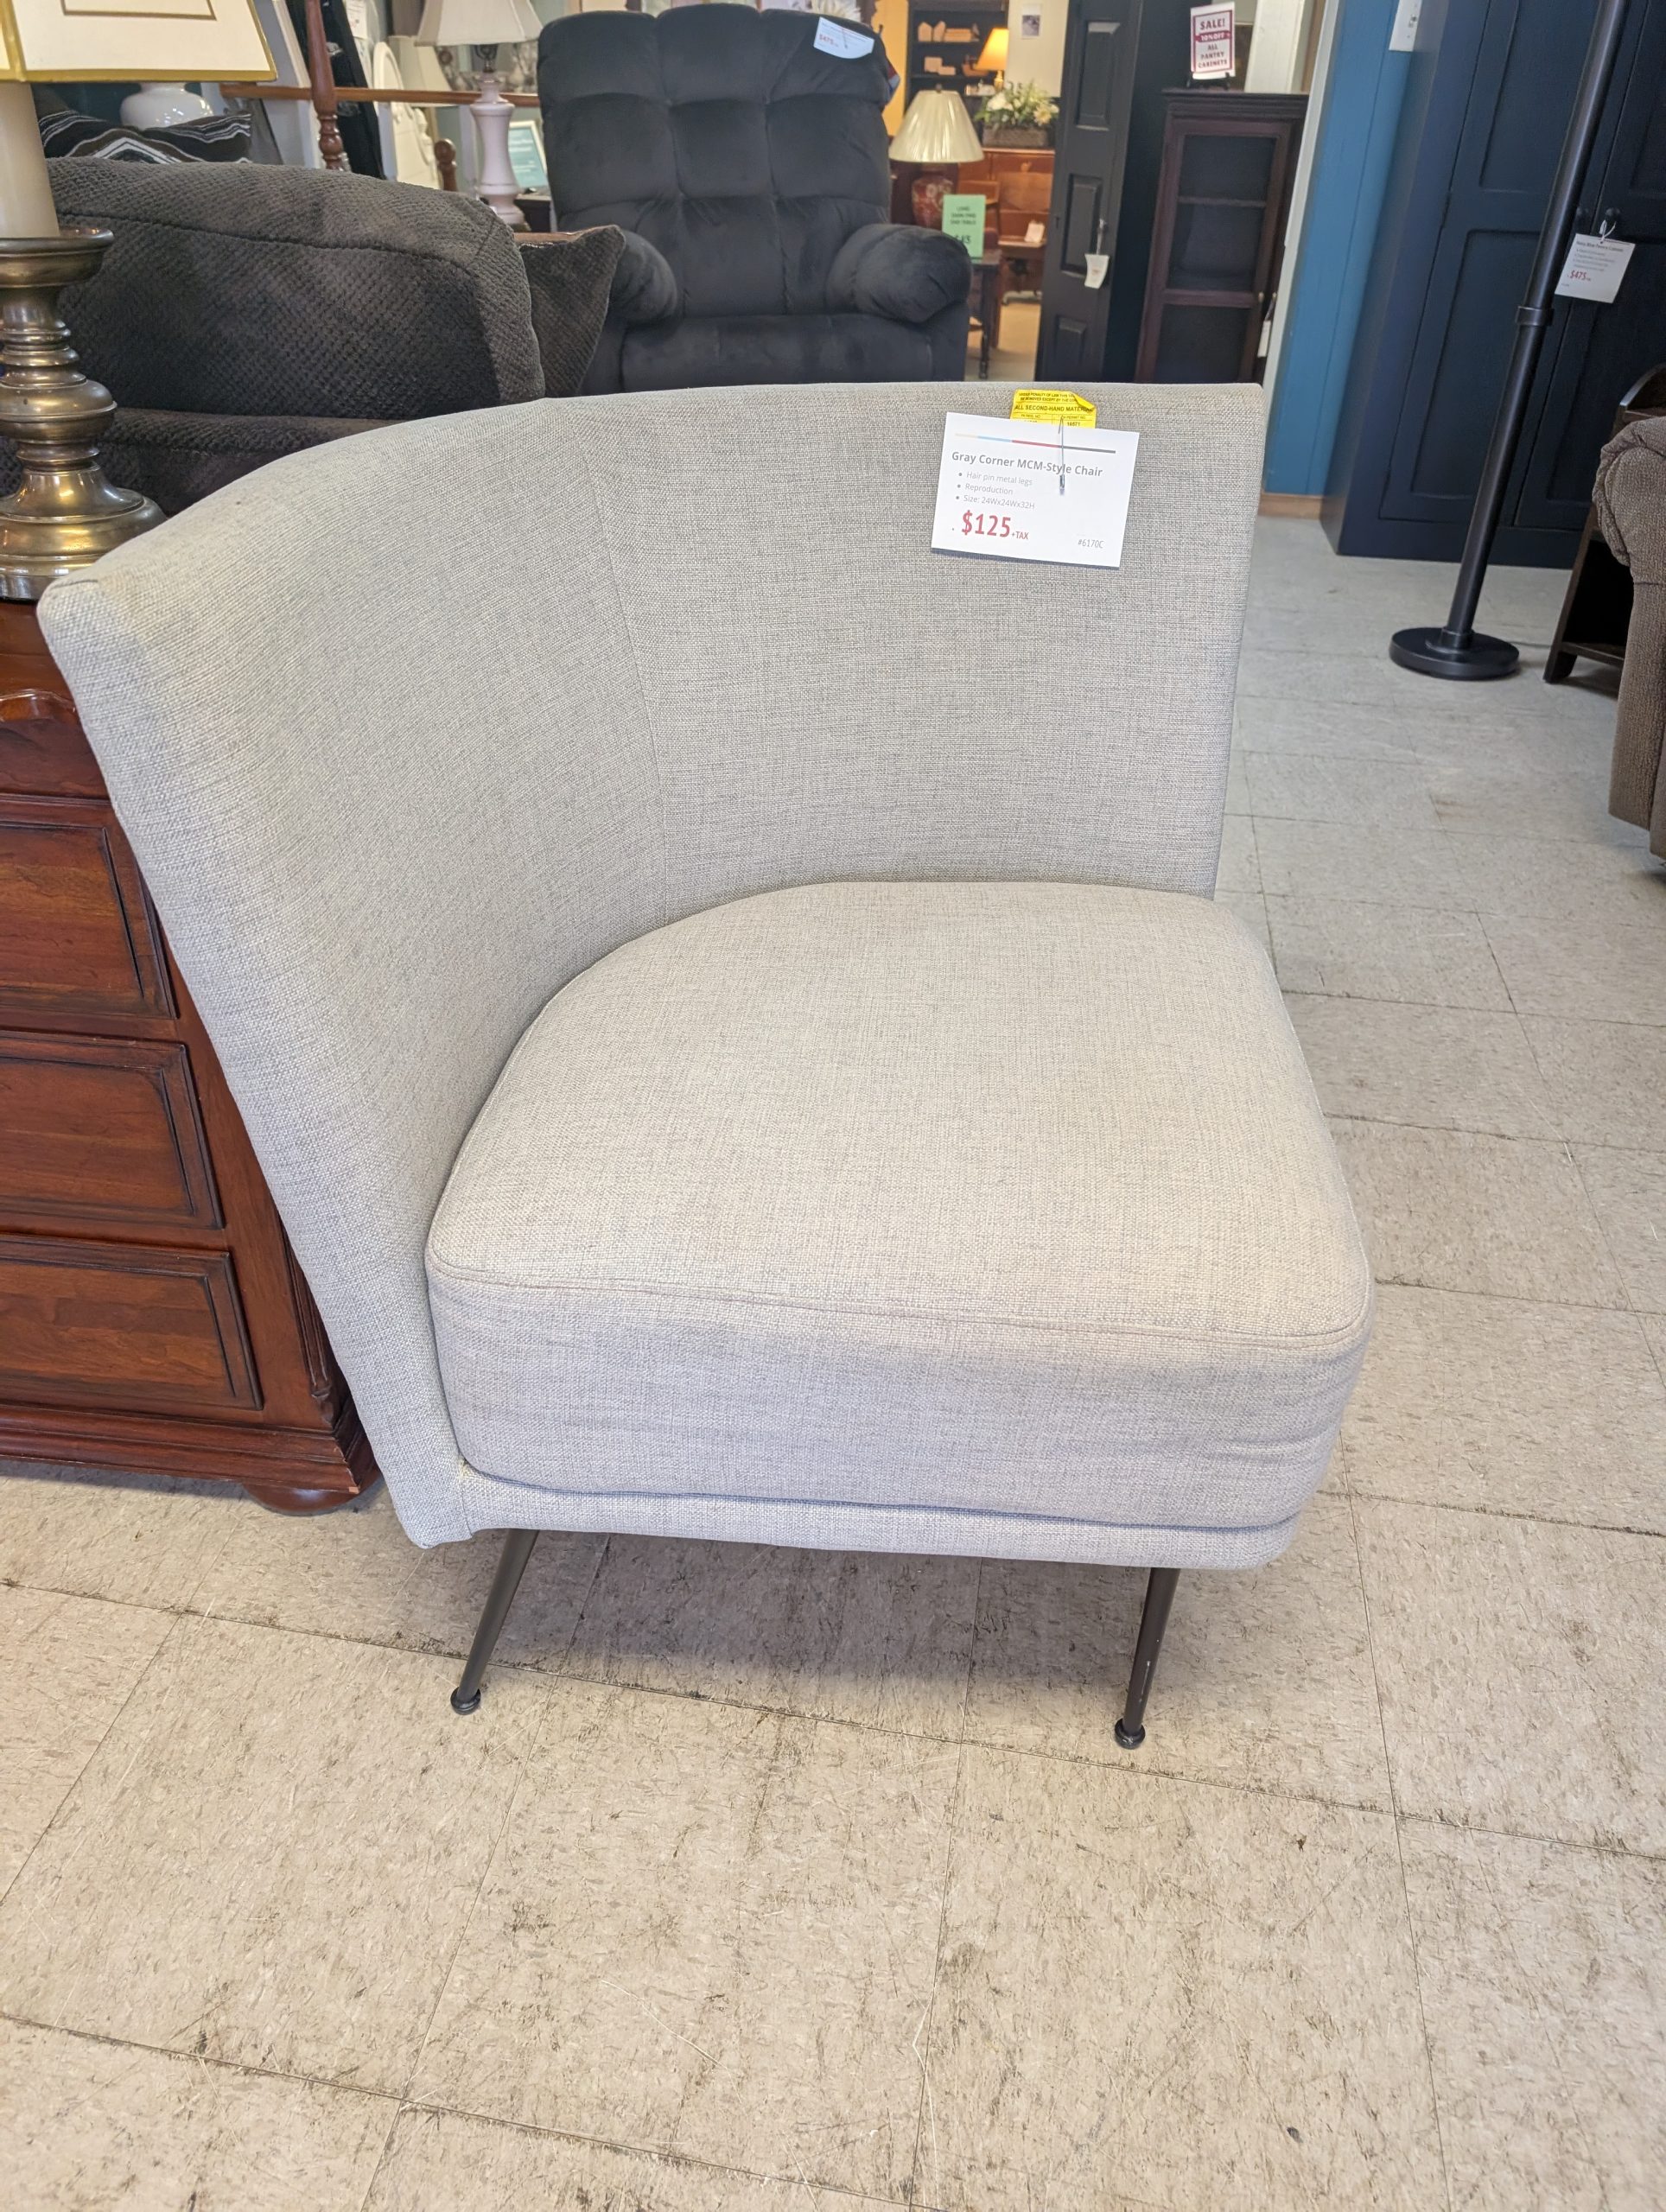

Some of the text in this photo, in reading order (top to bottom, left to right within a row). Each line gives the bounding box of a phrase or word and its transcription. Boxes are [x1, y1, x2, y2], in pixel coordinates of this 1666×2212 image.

[1200, 18, 1225, 30] SALE!
[1201, 51, 1224, 60] PANTRY
[1198, 60, 1227, 68] CABINETS
[951, 451, 1103, 477] Gray Corner MCM-Style Chair
[966, 471, 1033, 487] Hair pin metal legs
[965, 483, 1014, 495] Reproduction
[963, 494, 980, 504] Size:
[961, 509, 1011, 537] $125
